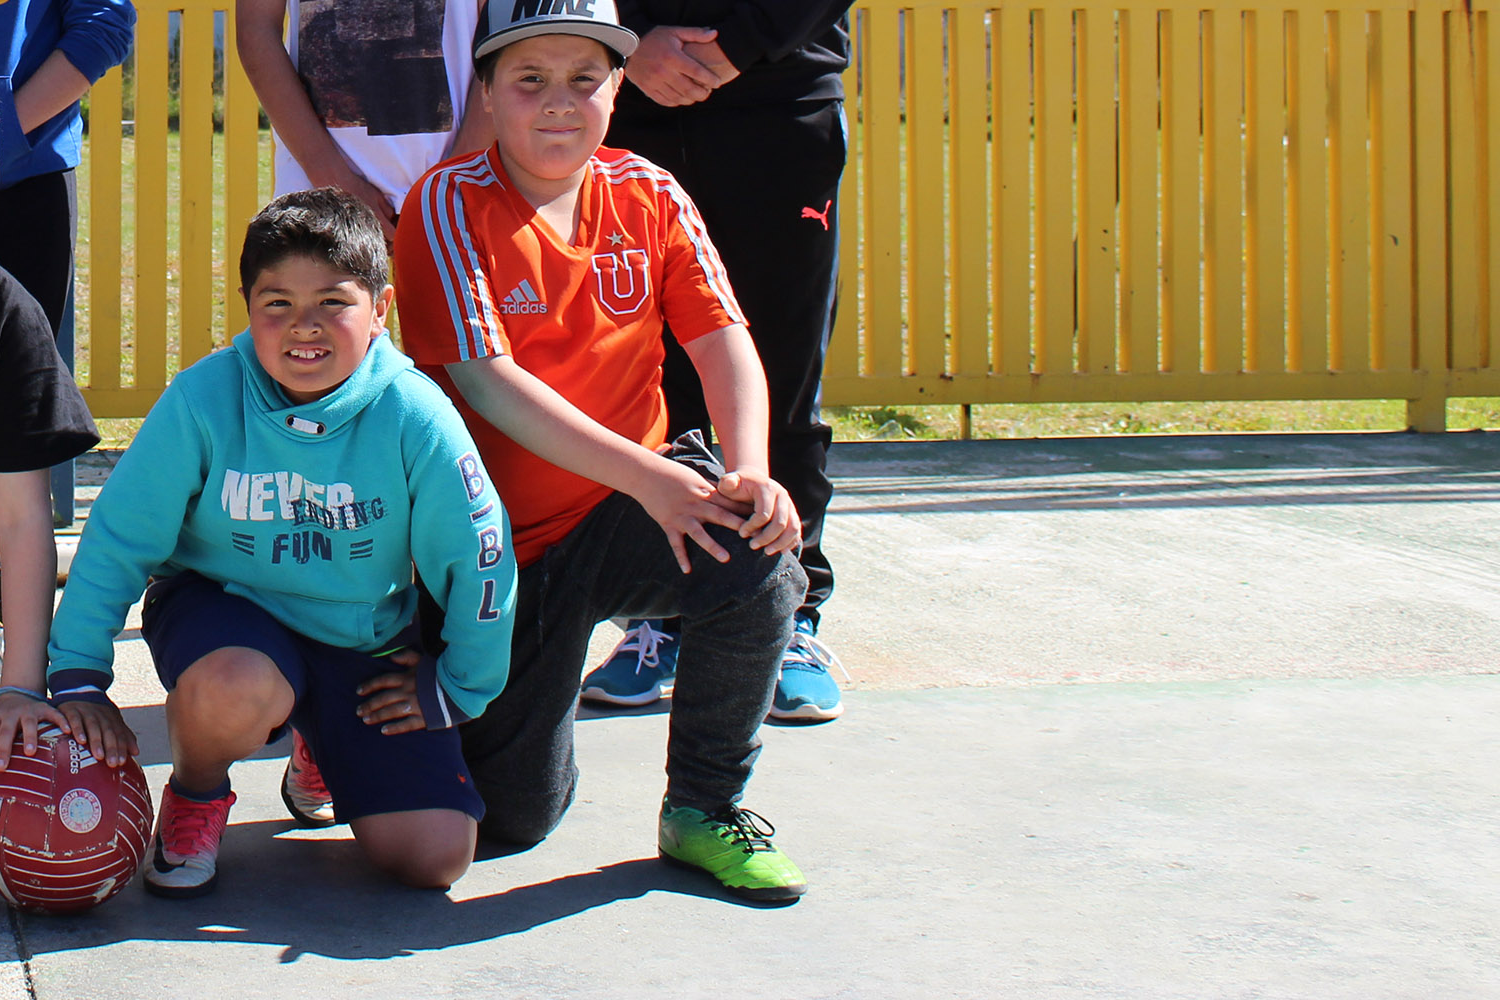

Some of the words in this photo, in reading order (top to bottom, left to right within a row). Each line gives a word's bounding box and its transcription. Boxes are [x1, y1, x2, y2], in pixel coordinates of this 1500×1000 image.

[499, 301, 548, 314] adidas
[221, 469, 356, 530] NEVER
[291, 496, 385, 531] ENDING
[271, 531, 333, 565] FUN
[68, 739, 80, 775] adidas
